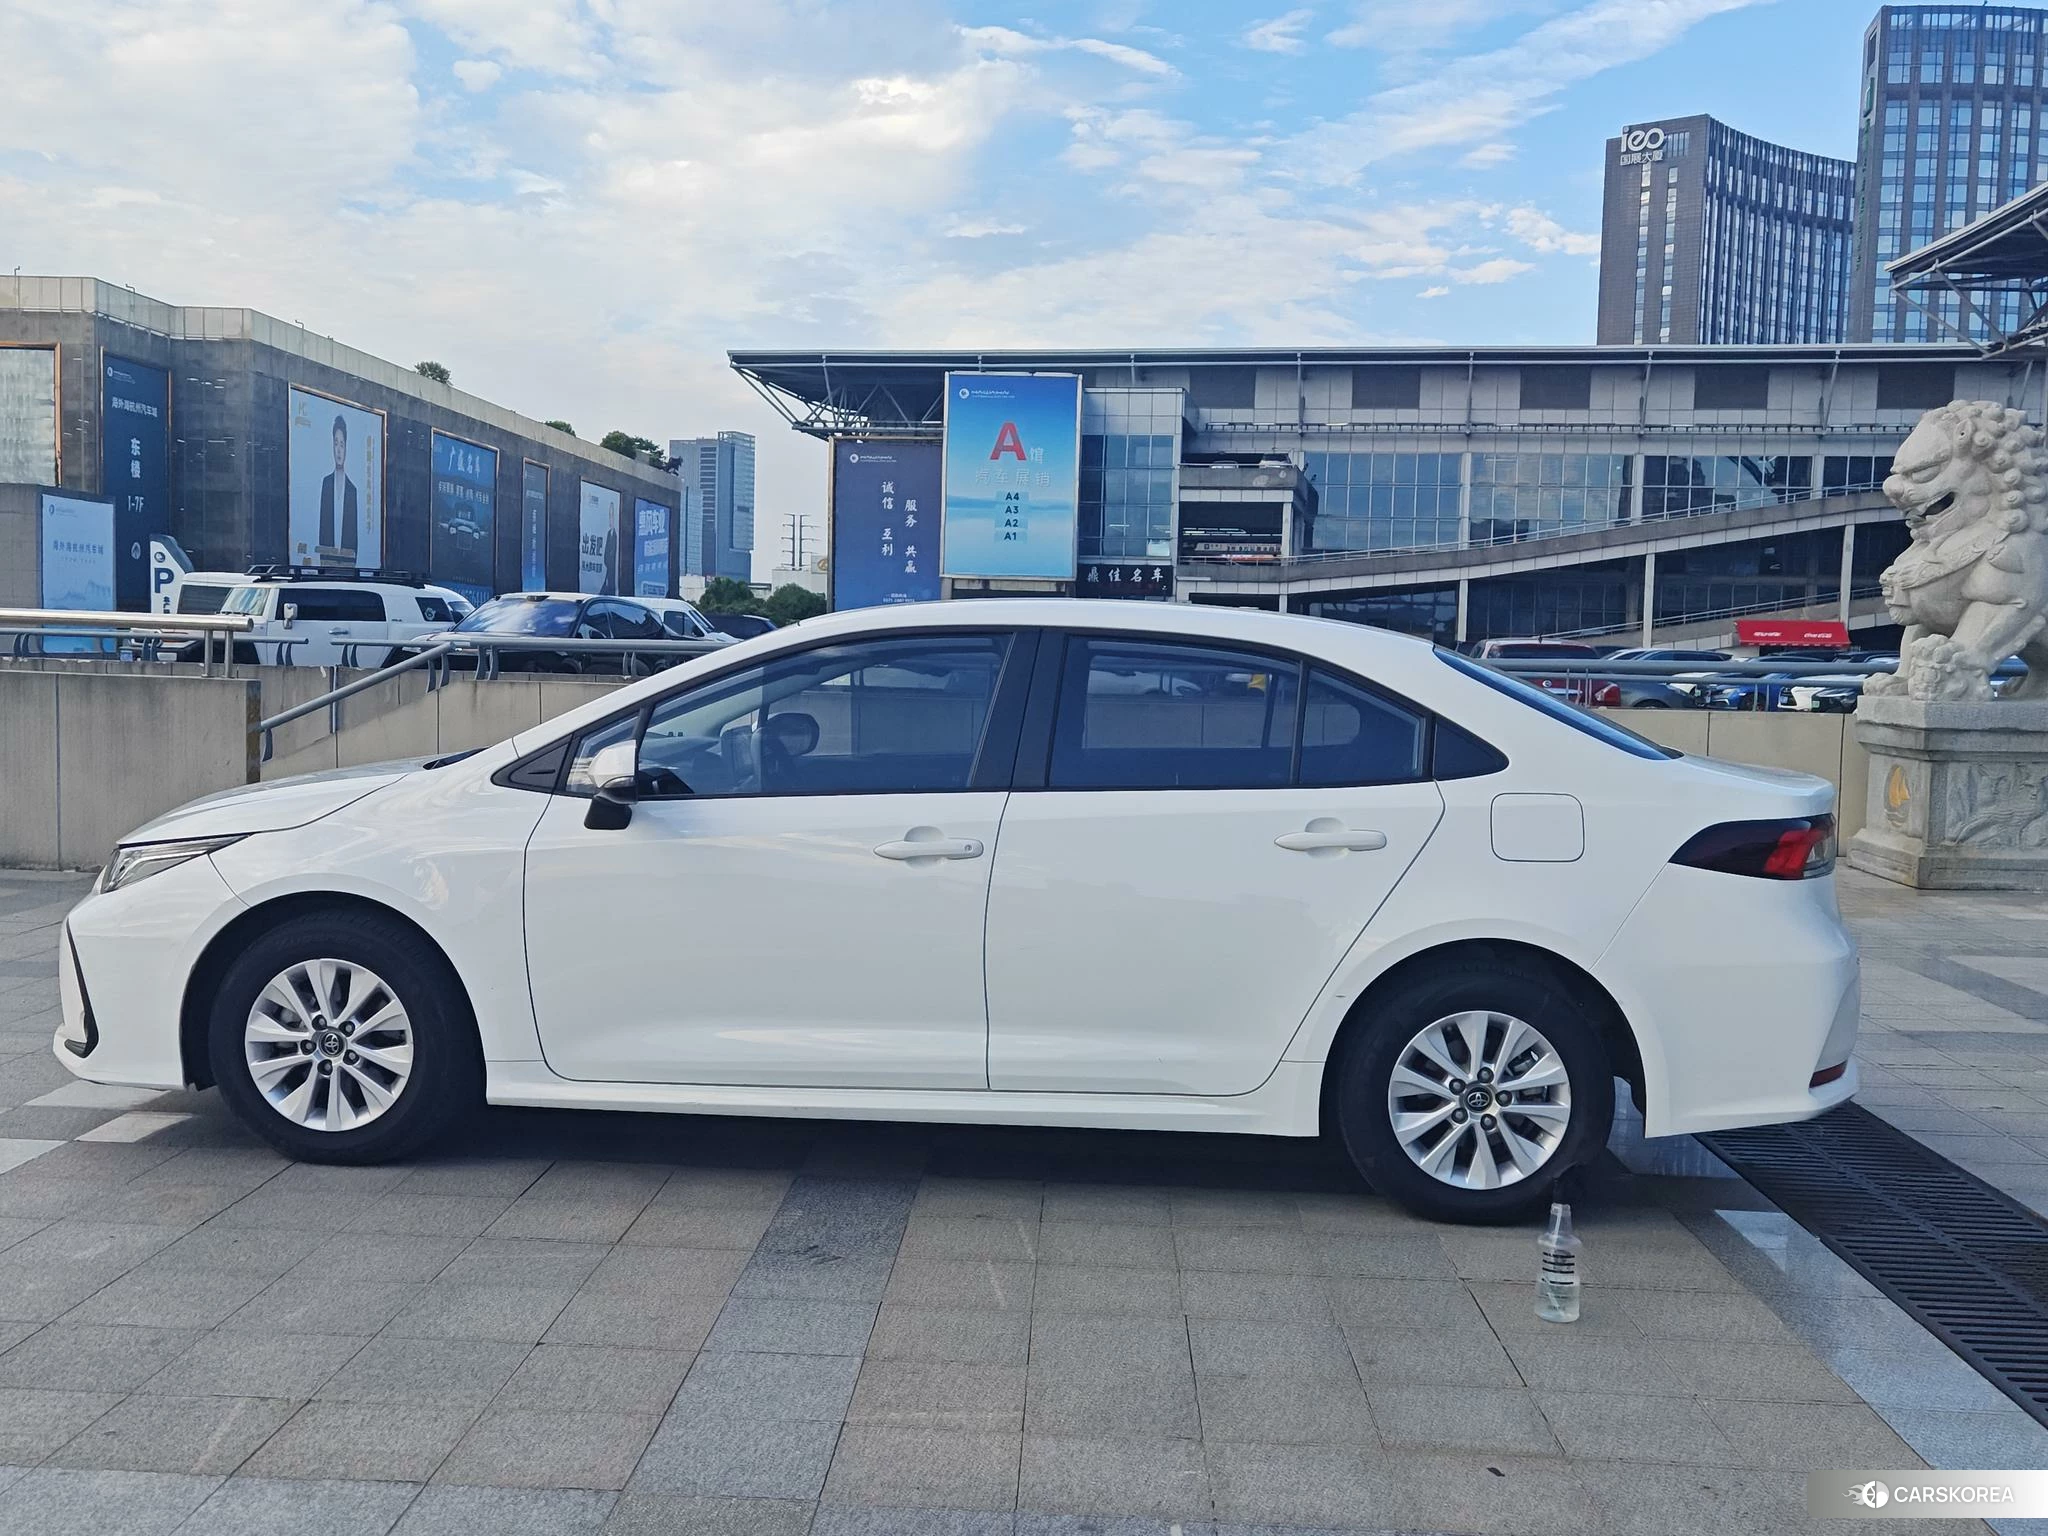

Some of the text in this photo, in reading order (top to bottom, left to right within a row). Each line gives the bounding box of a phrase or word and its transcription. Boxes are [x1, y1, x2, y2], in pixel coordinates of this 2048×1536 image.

[1620, 151, 1663, 166] 国展大厦
[990, 421, 1027, 461] A
[1005, 492, 1019, 501] A4
[1005, 505, 1019, 514] A3
[881, 481, 895, 556] 诚信 互利
[1004, 518, 1018, 527] A2
[904, 499, 918, 573] 服务 共赢
[1004, 531, 1017, 540] A1
[154, 567, 175, 594] P
[1087, 566, 1164, 583] 鼎佳名车
